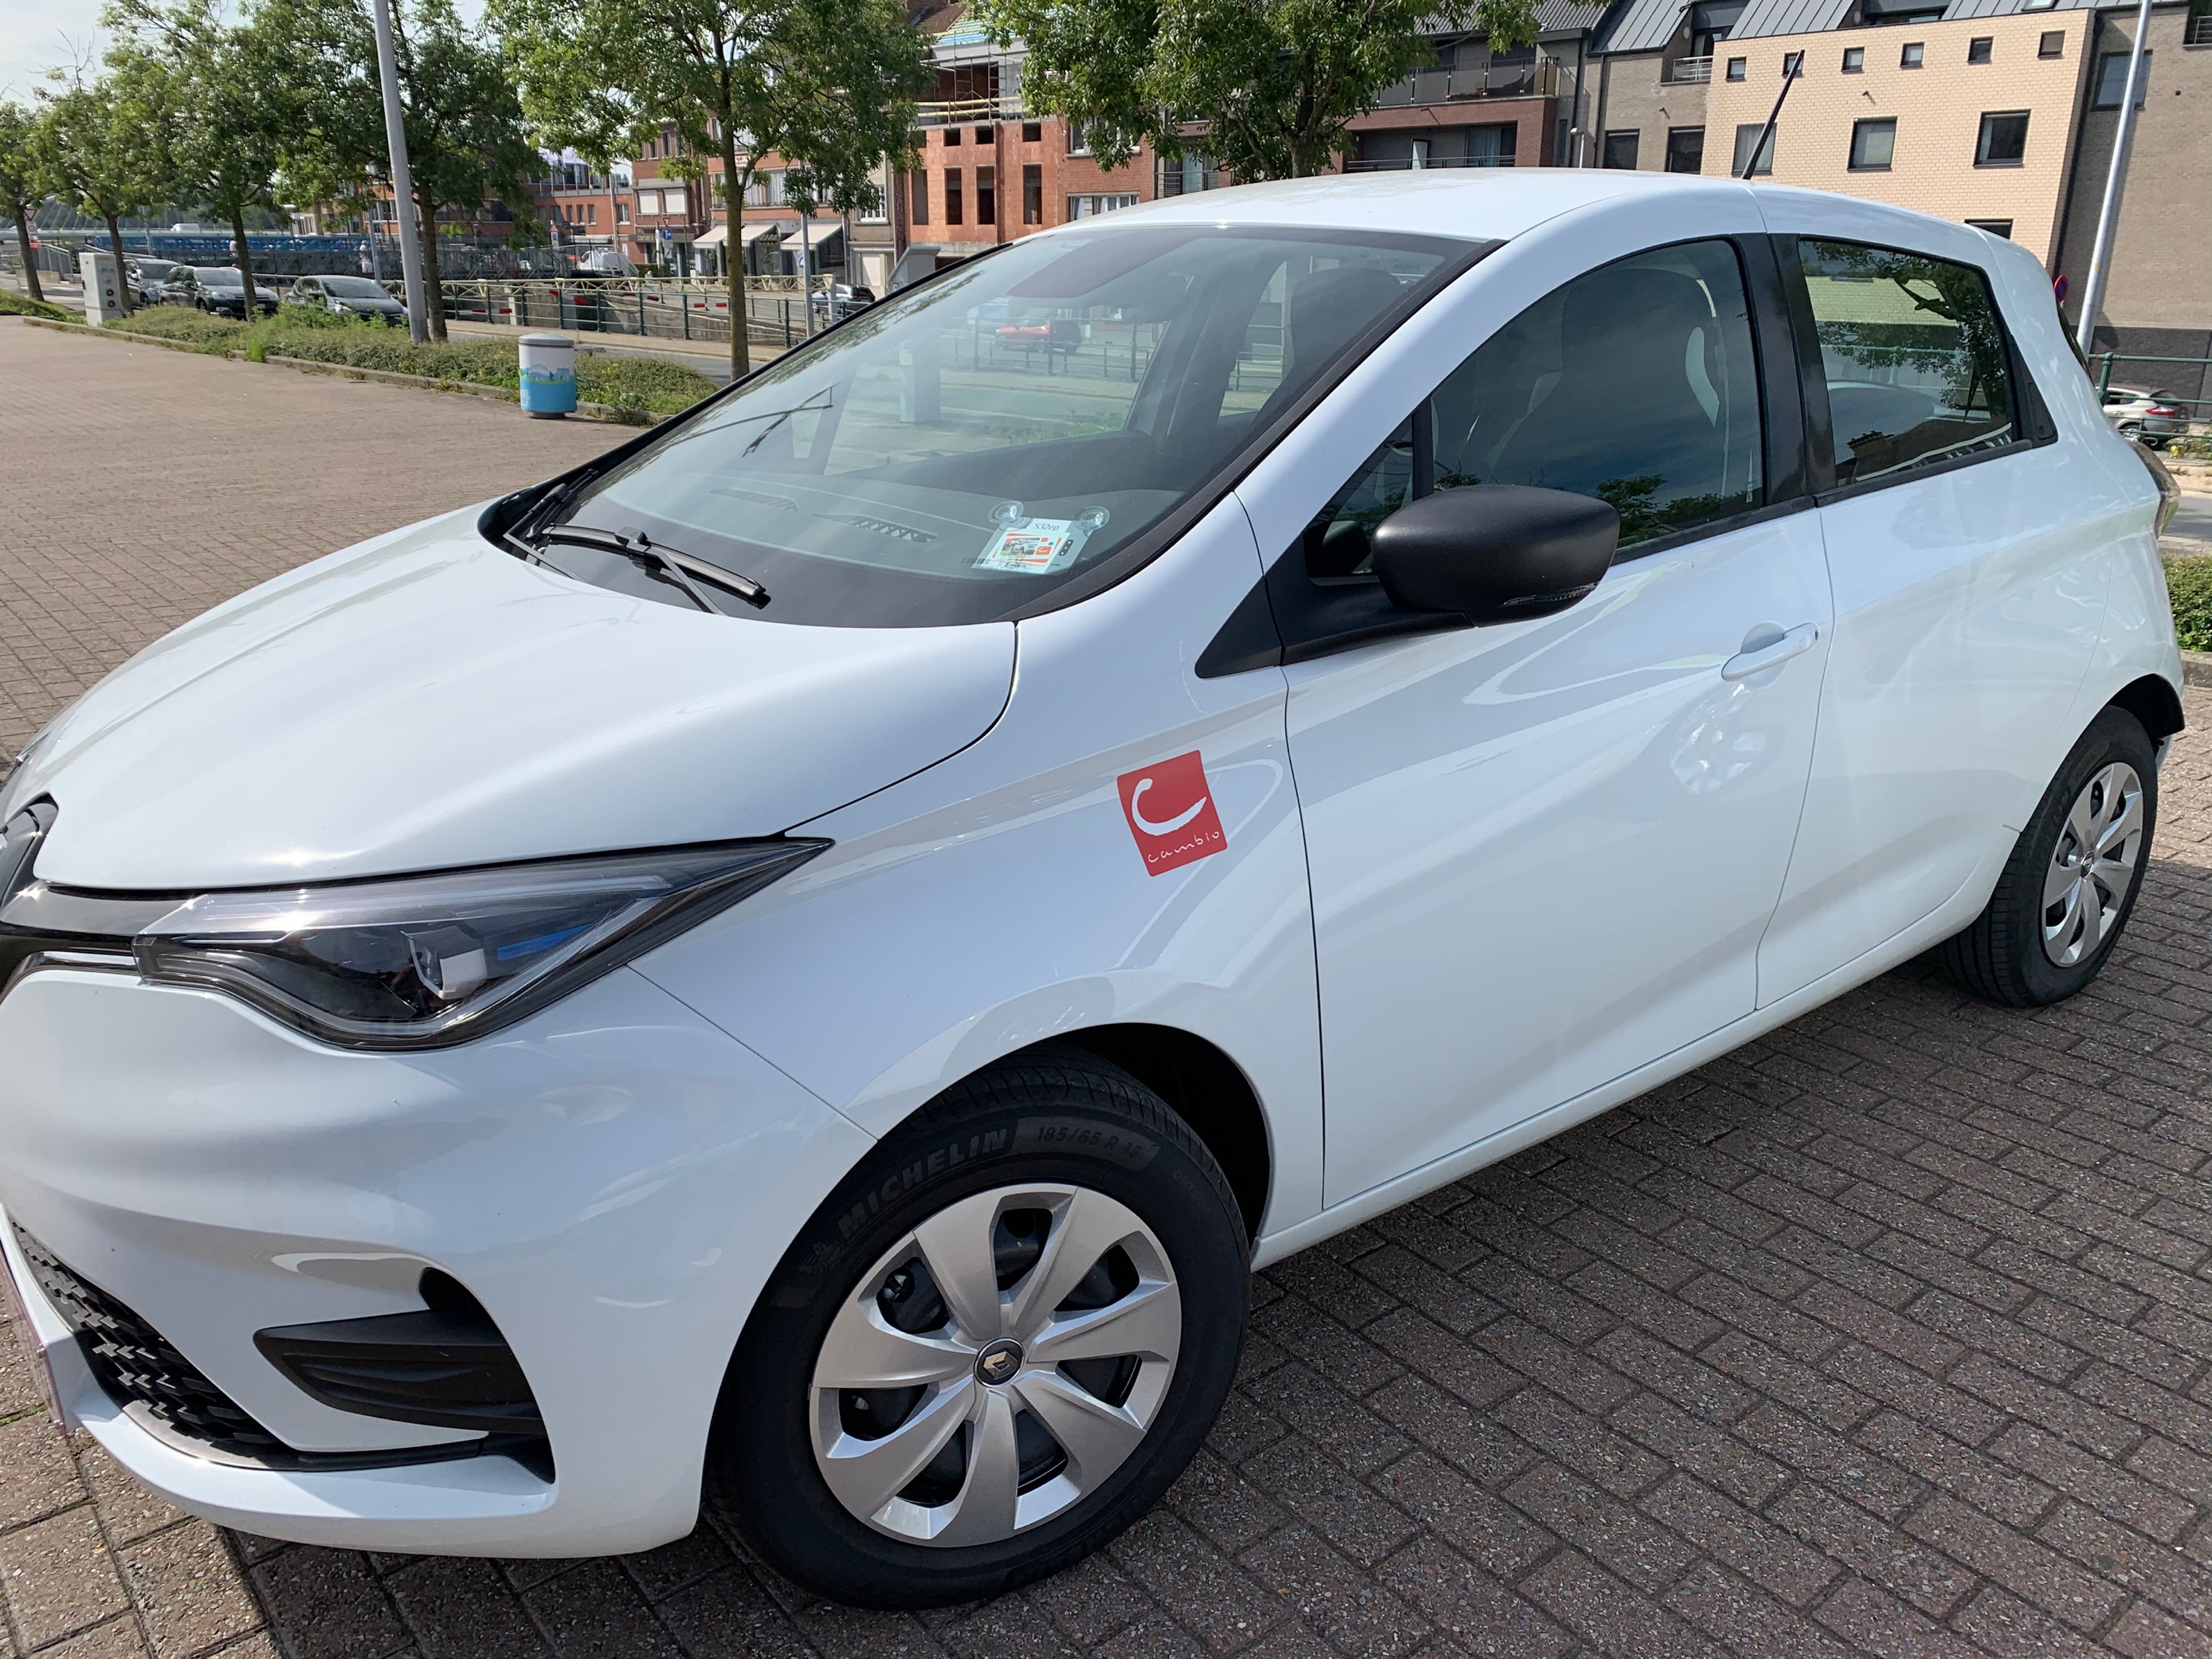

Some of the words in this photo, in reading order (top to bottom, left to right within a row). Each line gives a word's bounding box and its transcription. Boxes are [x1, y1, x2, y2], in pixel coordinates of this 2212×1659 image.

[1147, 831, 1220, 863] cambio
[1037, 1126, 1103, 1146] 185/65
[1104, 1135, 1120, 1150] R
[837, 1128, 1007, 1240] MICHELIN
